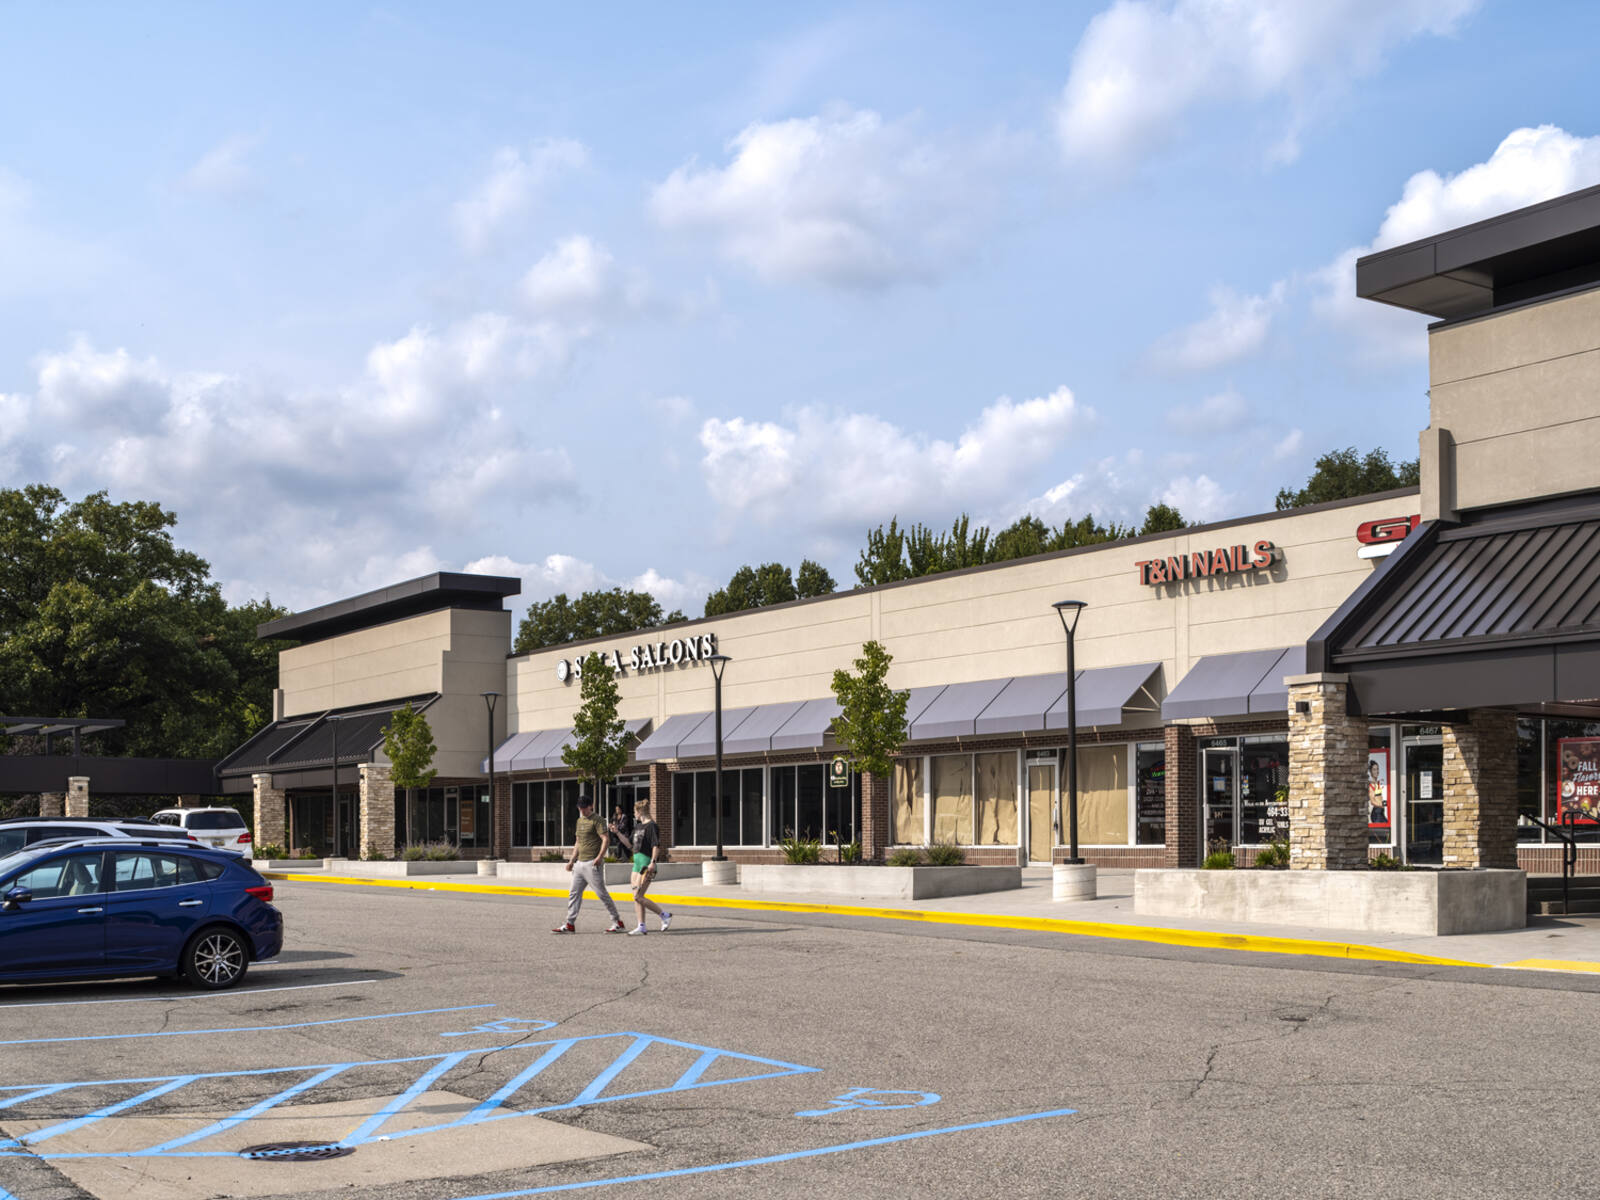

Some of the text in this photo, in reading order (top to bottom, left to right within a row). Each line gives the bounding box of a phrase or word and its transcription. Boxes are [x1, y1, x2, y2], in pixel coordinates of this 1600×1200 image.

[1135, 540, 1273, 585] T&N NAILS
[574, 633, 714, 679] SA SALONS
[1419, 727, 1439, 735] 6467
[1577, 761, 1598, 771] FALL
[1573, 772, 1600, 782] Flavor
[1576, 785, 1599, 795] HERE
